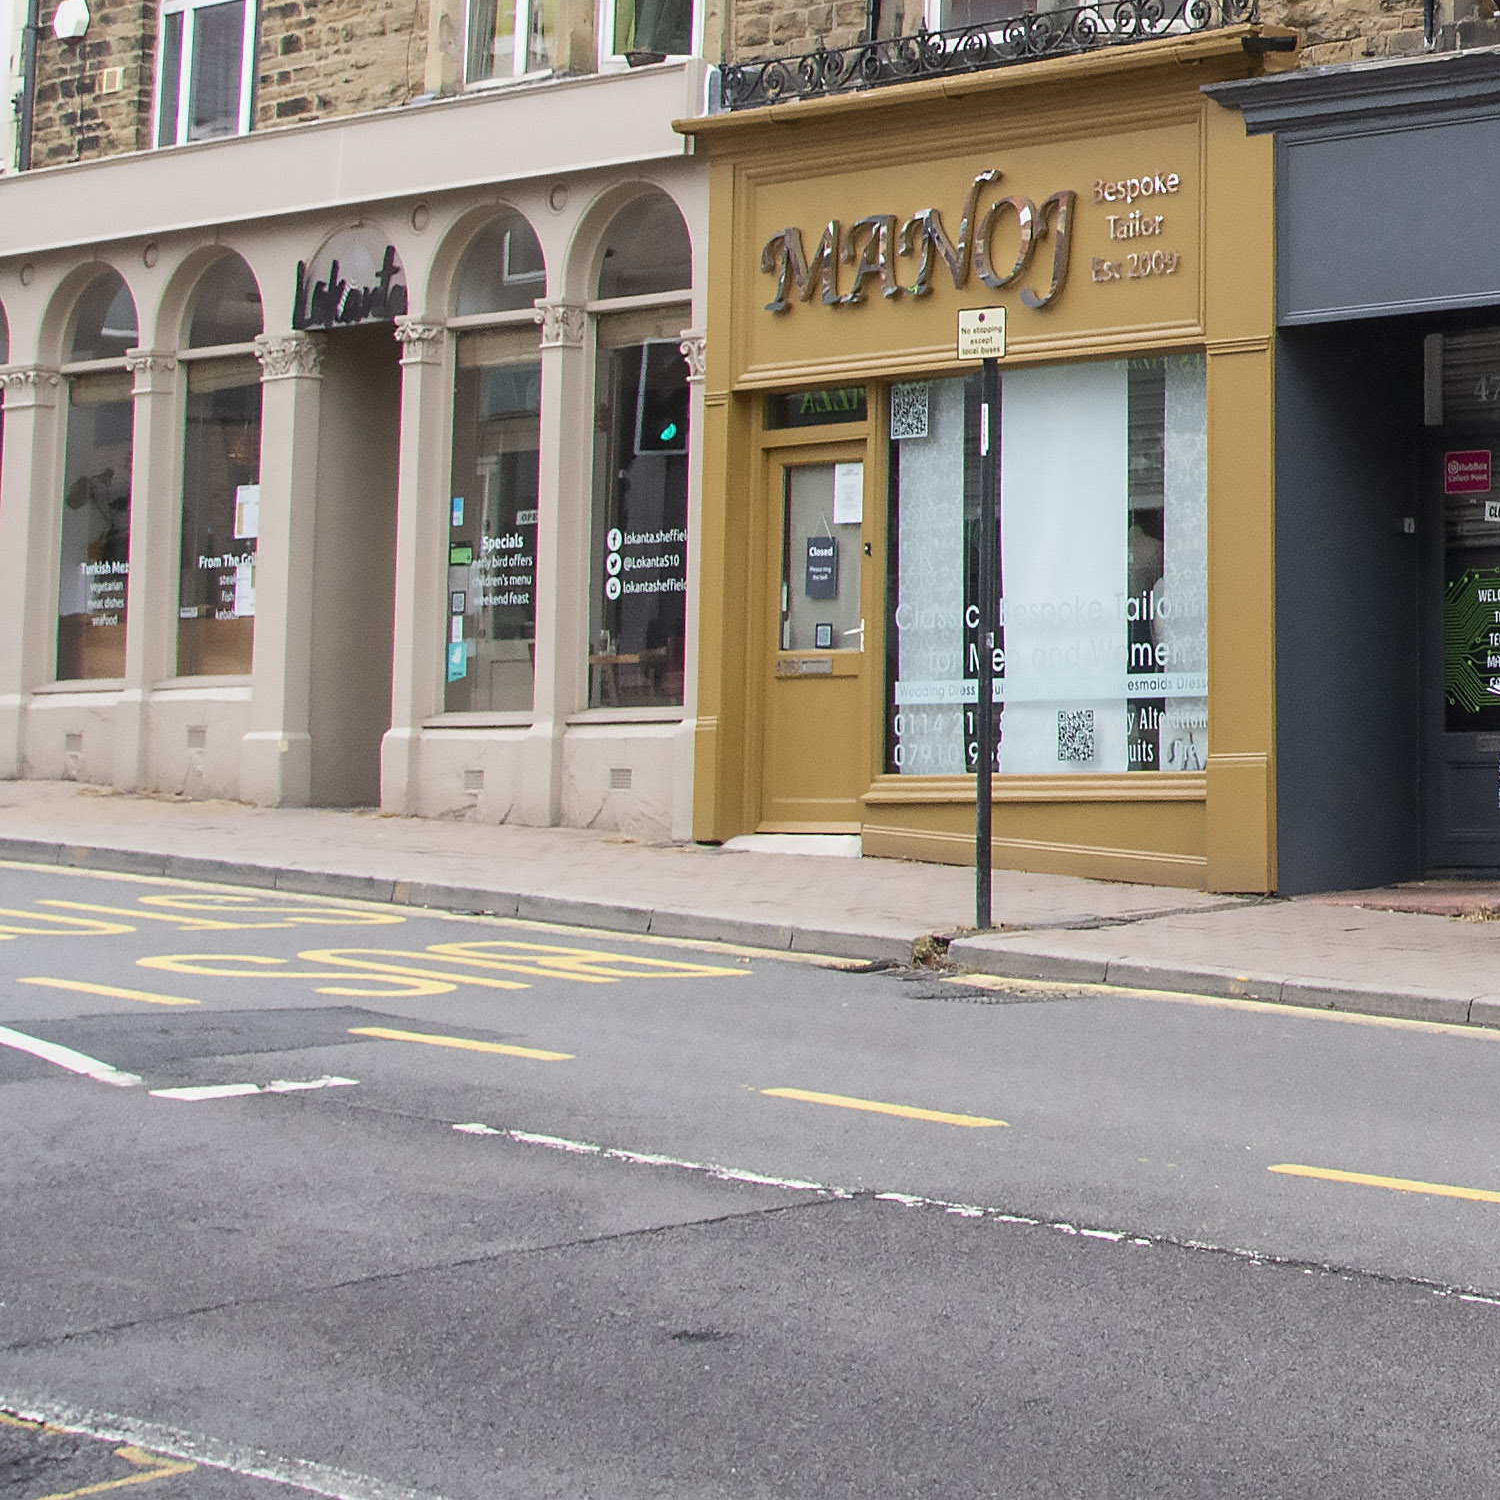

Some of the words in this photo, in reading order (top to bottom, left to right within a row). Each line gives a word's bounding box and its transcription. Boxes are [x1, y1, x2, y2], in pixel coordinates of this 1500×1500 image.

[1092, 168, 1180, 204] Bespoke
[1105, 209, 1164, 240] Tailor
[761, 169, 1078, 313] MANOJ
[1126, 249, 1180, 278] 2009
[961, 327, 972, 335] No
[973, 325, 1003, 334] stopping
[970, 336, 993, 344] except
[481, 532, 524, 554] Specials
[624, 528, 688, 545] lokanta.sheffiel
[491, 555, 508, 567] bird
[509, 553, 533, 567] offers
[809, 546, 834, 557] Closed
[80, 560, 111, 577] Turkish
[199, 555, 221, 569] From
[222, 553, 239, 567] The
[623, 554, 680, 571] @LokantaS10
[472, 573, 509, 587] children's
[509, 575, 532, 587] menu
[473, 593, 509, 606] weekend
[509, 592, 530, 605] feast
